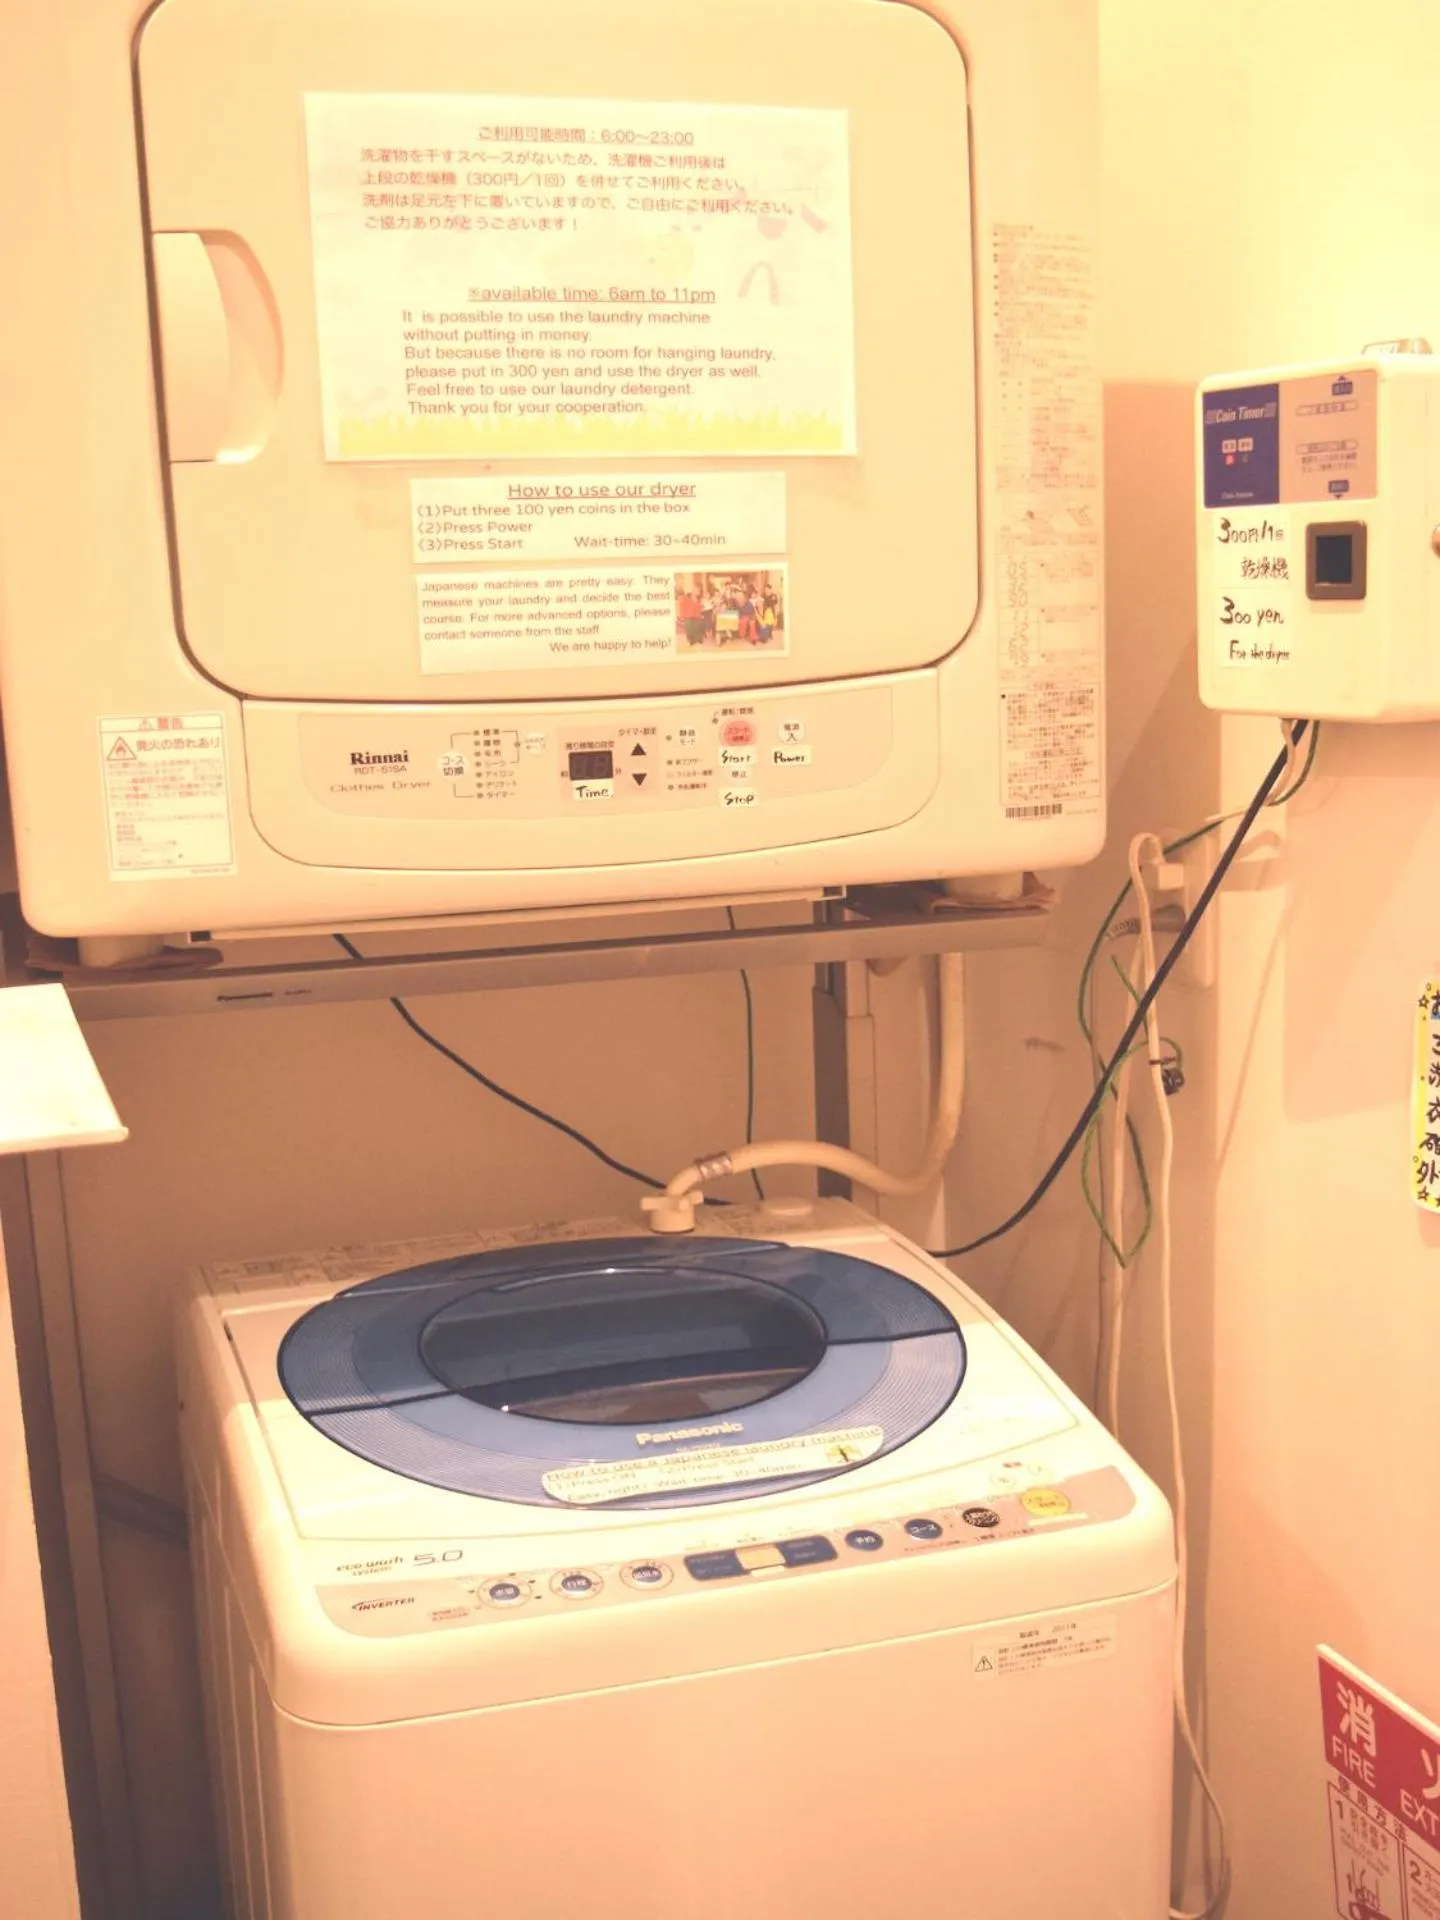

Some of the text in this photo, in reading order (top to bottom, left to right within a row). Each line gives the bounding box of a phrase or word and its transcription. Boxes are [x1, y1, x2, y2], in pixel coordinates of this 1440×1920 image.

[608, 286, 645, 301] 6am
[651, 288, 667, 301] to
[673, 287, 716, 304] 11pm
[402, 309, 711, 326] It is possible to use the laundry machine
[403, 329, 459, 341] without
[464, 329, 516, 343] putting
[521, 329, 534, 341] in
[404, 346, 431, 359] But
[436, 346, 501, 359] because
[506, 347, 545, 359] there
[550, 347, 562, 358] is
[567, 348, 585, 359] no
[591, 348, 628, 359] room
[634, 346, 651, 359] for
[657, 346, 716, 361] hanging
[405, 365, 457, 380] please
[462, 366, 486, 380] put
[490, 366, 504, 377] in
[508, 364, 537, 377] 300
[542, 367, 569, 380] yen
[574, 365, 602, 377] and
[607, 367, 634, 377] use
[639, 365, 662, 377] the
[666, 365, 703, 379] dryer
[708, 367, 725, 377] as
[407, 383, 694, 397] Feel free to use our laundry detergent.
[408, 401, 456, 413] Thank
[460, 403, 488, 416] you
[493, 400, 512, 413] for
[518, 403, 550, 415] your
[1215, 405, 1265, 424] Coin Timer
[508, 482, 696, 498] How to use our dryer
[472, 504, 511, 516] three
[517, 503, 544, 516] 100
[548, 504, 574, 518] yen
[579, 502, 616, 515] coins
[620, 502, 632, 514] in
[637, 502, 660, 513] the
[664, 502, 690, 513] box
[487, 521, 533, 533] Power
[488, 538, 523, 550] Start
[422, 581, 478, 592] Japanese
[484, 579, 539, 590] machines
[545, 579, 563, 588] are
[568, 577, 600, 588] pretty
[643, 575, 671, 586] They
[422, 592, 671, 608] measure your laundry and decide the best
[470, 612, 490, 623] For
[494, 613, 523, 622] more
[527, 610, 582, 621] advanced
[634, 608, 671, 619] please
[1220, 596, 1284, 628] 300 yen
[424, 630, 466, 640] contact
[469, 630, 522, 639] someone
[525, 627, 551, 637] from
[554, 626, 573, 636] the
[549, 638, 671, 652] We are happy to help!
[350, 750, 409, 765] Rinnai
[721, 750, 751, 764] Start
[773, 751, 805, 764] Power
[576, 785, 610, 798] Time
[636, 1422, 745, 1446] Panasonic
[613, 1462, 643, 1473] use
[413, 1549, 463, 1567] 5.0
[1332, 1735, 1377, 1789] FIRE
[1409, 1859, 1423, 1886] 2
